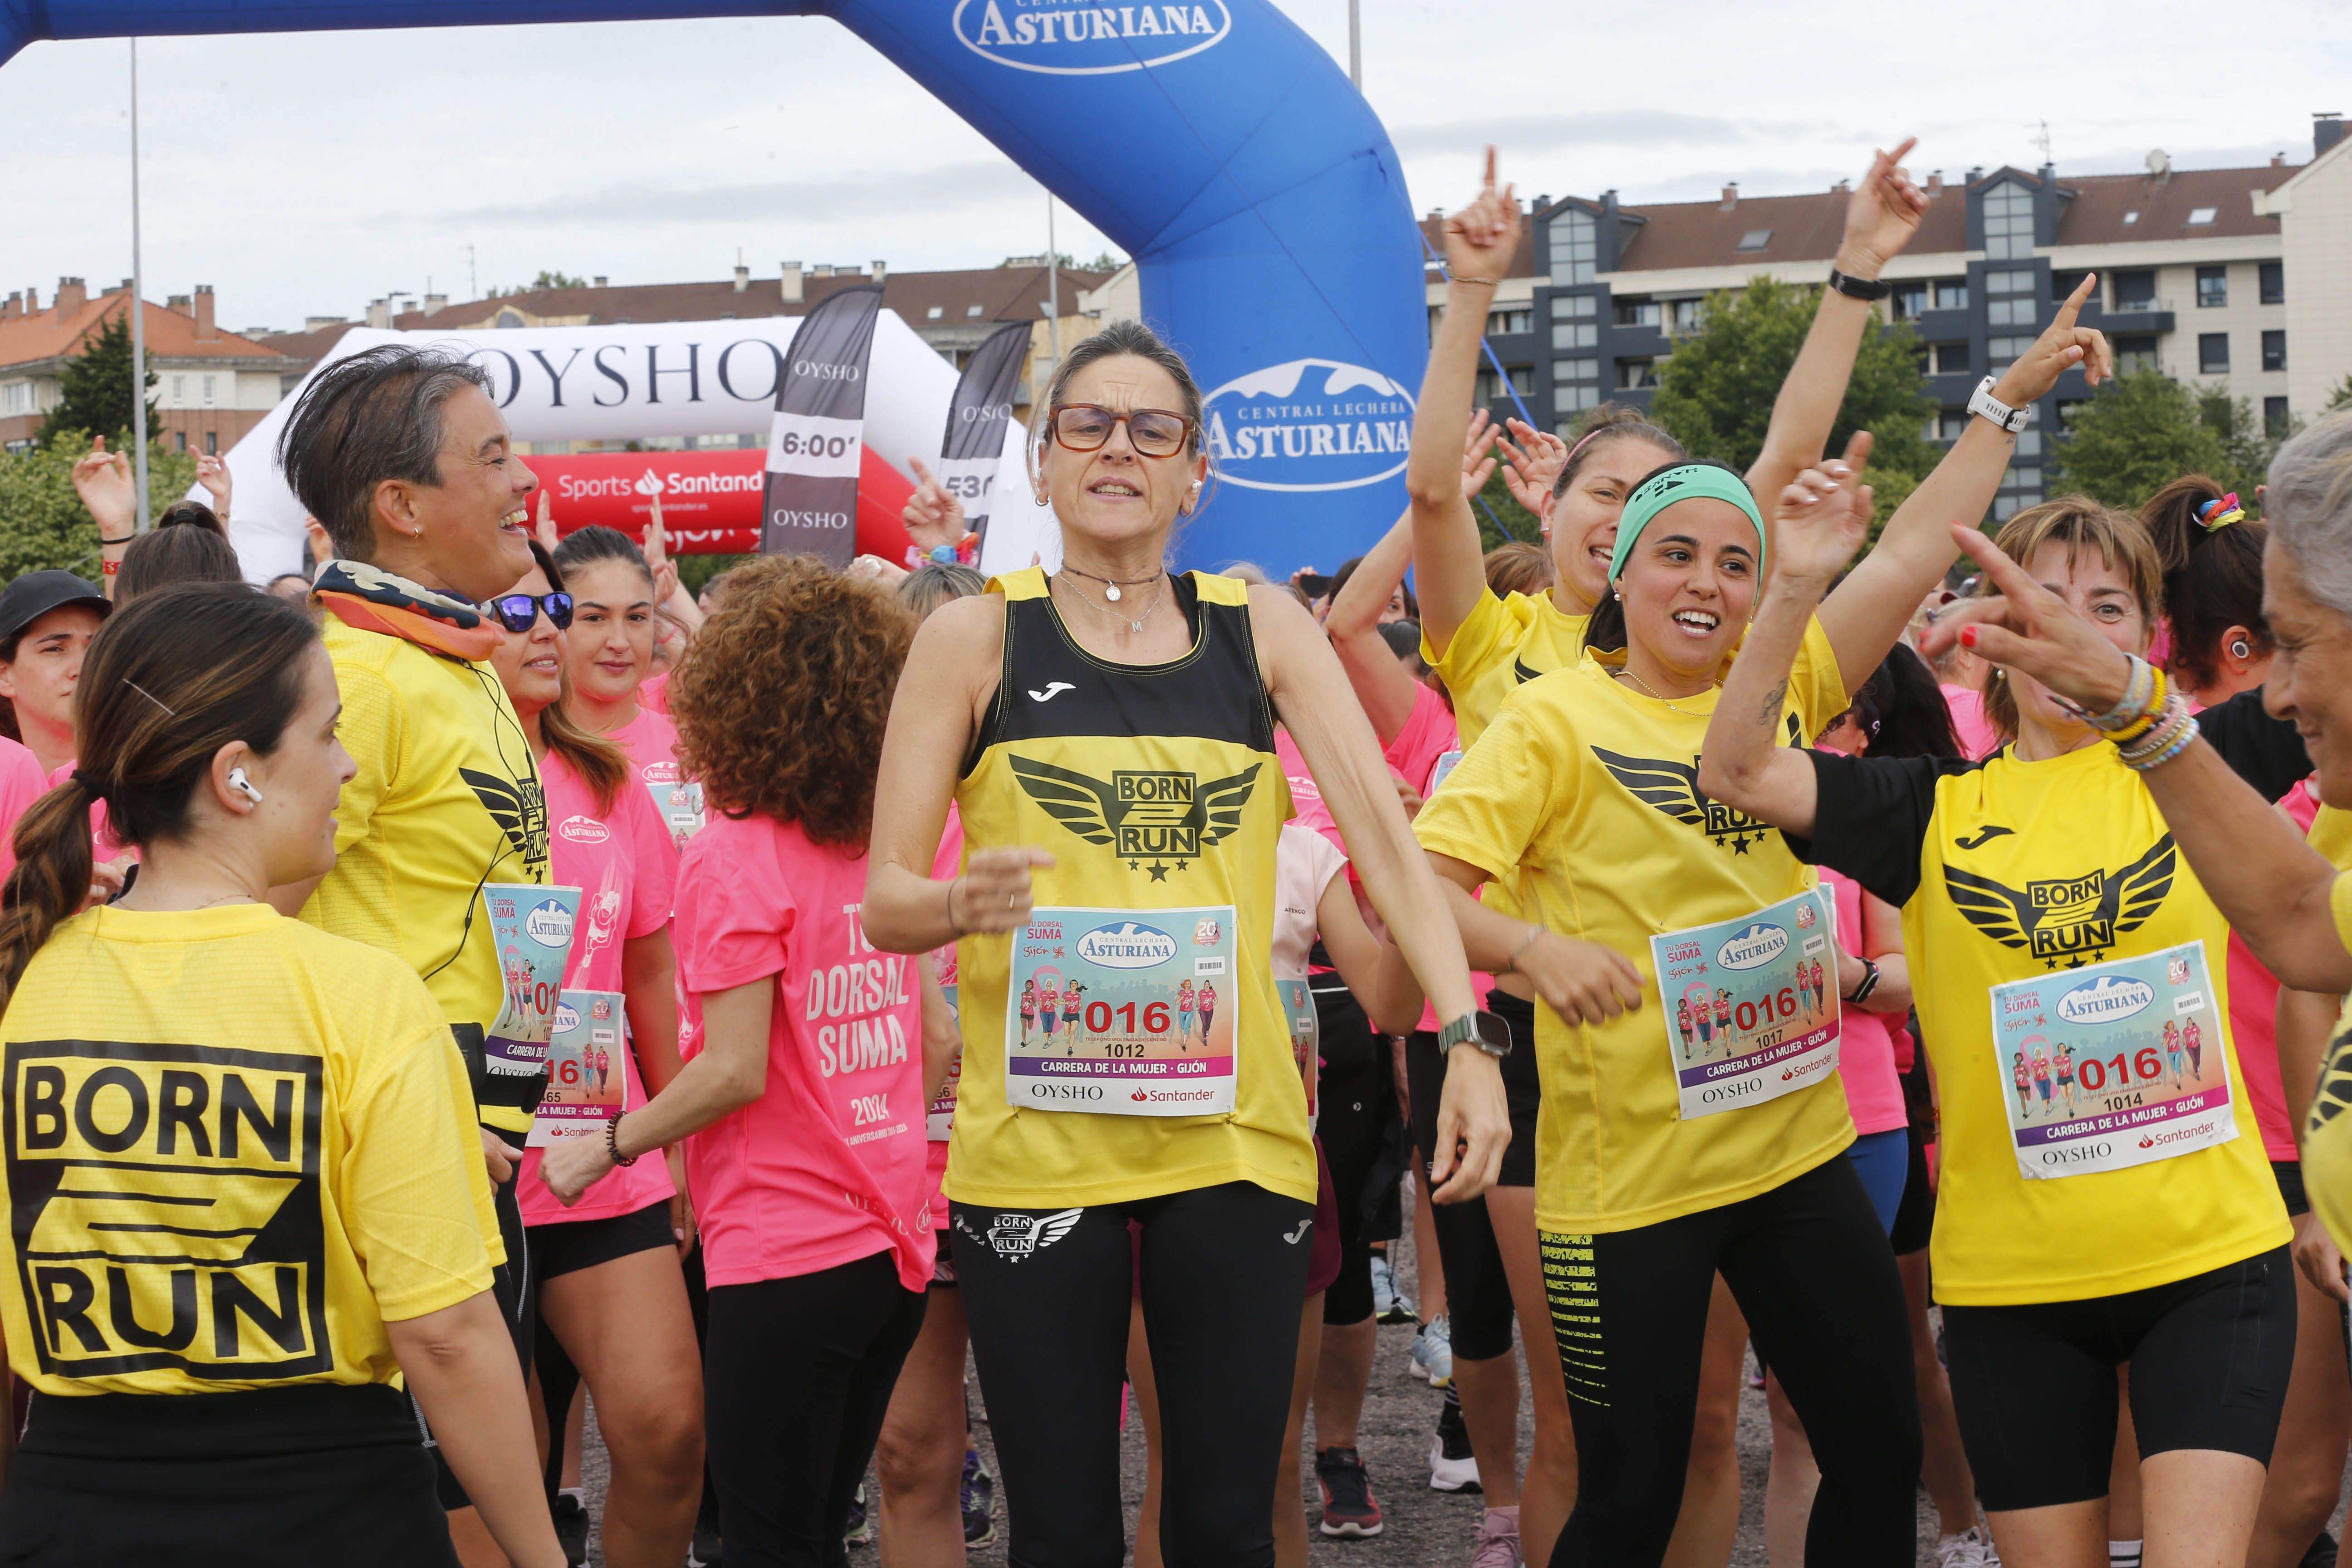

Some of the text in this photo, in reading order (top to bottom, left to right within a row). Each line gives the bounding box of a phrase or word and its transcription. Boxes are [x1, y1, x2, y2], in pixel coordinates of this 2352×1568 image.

[977, 0, 1216, 45] ASTURIANA
[795, 359, 859, 382] OYSHO
[1238, 401, 1406, 421] CENTRAL LECHERA
[1208, 411, 1410, 460] ASTURIANA
[559, 470, 764, 501] Sports Santand
[774, 509, 848, 529] OYSHO
[672, 791, 686, 801] 20
[1120, 777, 1191, 800] BORN
[1710, 806, 1757, 830] RU
[565, 825, 607, 837] ASTURIANA
[1122, 828, 1193, 852] RUN
[2034, 875, 2100, 905] BORN
[494, 907, 515, 918] SUMA
[1798, 905, 1811, 921] 20
[1027, 928, 1062, 940] SUMA
[1198, 921, 1216, 936] 20
[2037, 921, 2109, 952] RUN
[1024, 945, 1049, 958] gijón
[1083, 938, 1171, 957] ASTURIANA
[1667, 947, 1702, 963] SUMA
[1675, 940, 1700, 951] DORSAL
[1724, 936, 1786, 965] ASTURIANA
[1668, 966, 1693, 980] gijón
[2169, 960, 2185, 977] 20
[535, 981, 562, 1015] 01
[806, 956, 909, 1022] DORSAL
[2014, 990, 2039, 1000] DORSAL
[1735, 987, 1797, 1031] 016
[2004, 997, 2041, 1014] SUMA
[2064, 991, 2149, 1018] ASTURIANA
[1085, 1001, 1171, 1034] 016
[2004, 1016, 2031, 1032] gijón
[818, 1014, 907, 1078] SUMA
[1756, 1029, 1783, 1049] 1017
[507, 1044, 535, 1058] CARRERA
[536, 1047, 543, 1057] DE
[1104, 1044, 1145, 1058] 1012
[1706, 1029, 1828, 1078] CARRERA DE LA MUJER GIJÓN
[544, 1059, 579, 1084] 16
[1041, 1058, 1207, 1075] CARRERA DE LA MUJER GIJÓN
[2078, 1047, 2162, 1091] 016
[1702, 1052, 1833, 1104] OYSHO Santander
[1031, 1084, 1215, 1102] OYSHO Santander
[2104, 1092, 2143, 1112] 1014
[24, 1065, 294, 1163] BORN
[537, 1105, 603, 1116] LA MUJER GIJÓN
[850, 1092, 890, 1127] 2024
[2046, 1095, 2205, 1139] CARRERA DE LA MUJER GIJÓN
[850, 1128, 887, 1146] ANIVERSARIO
[2043, 1121, 2215, 1165] OYSHO Santander
[994, 1216, 1030, 1228] BORN
[996, 1240, 1032, 1250] RUN
[35, 1265, 307, 1358] RUN
